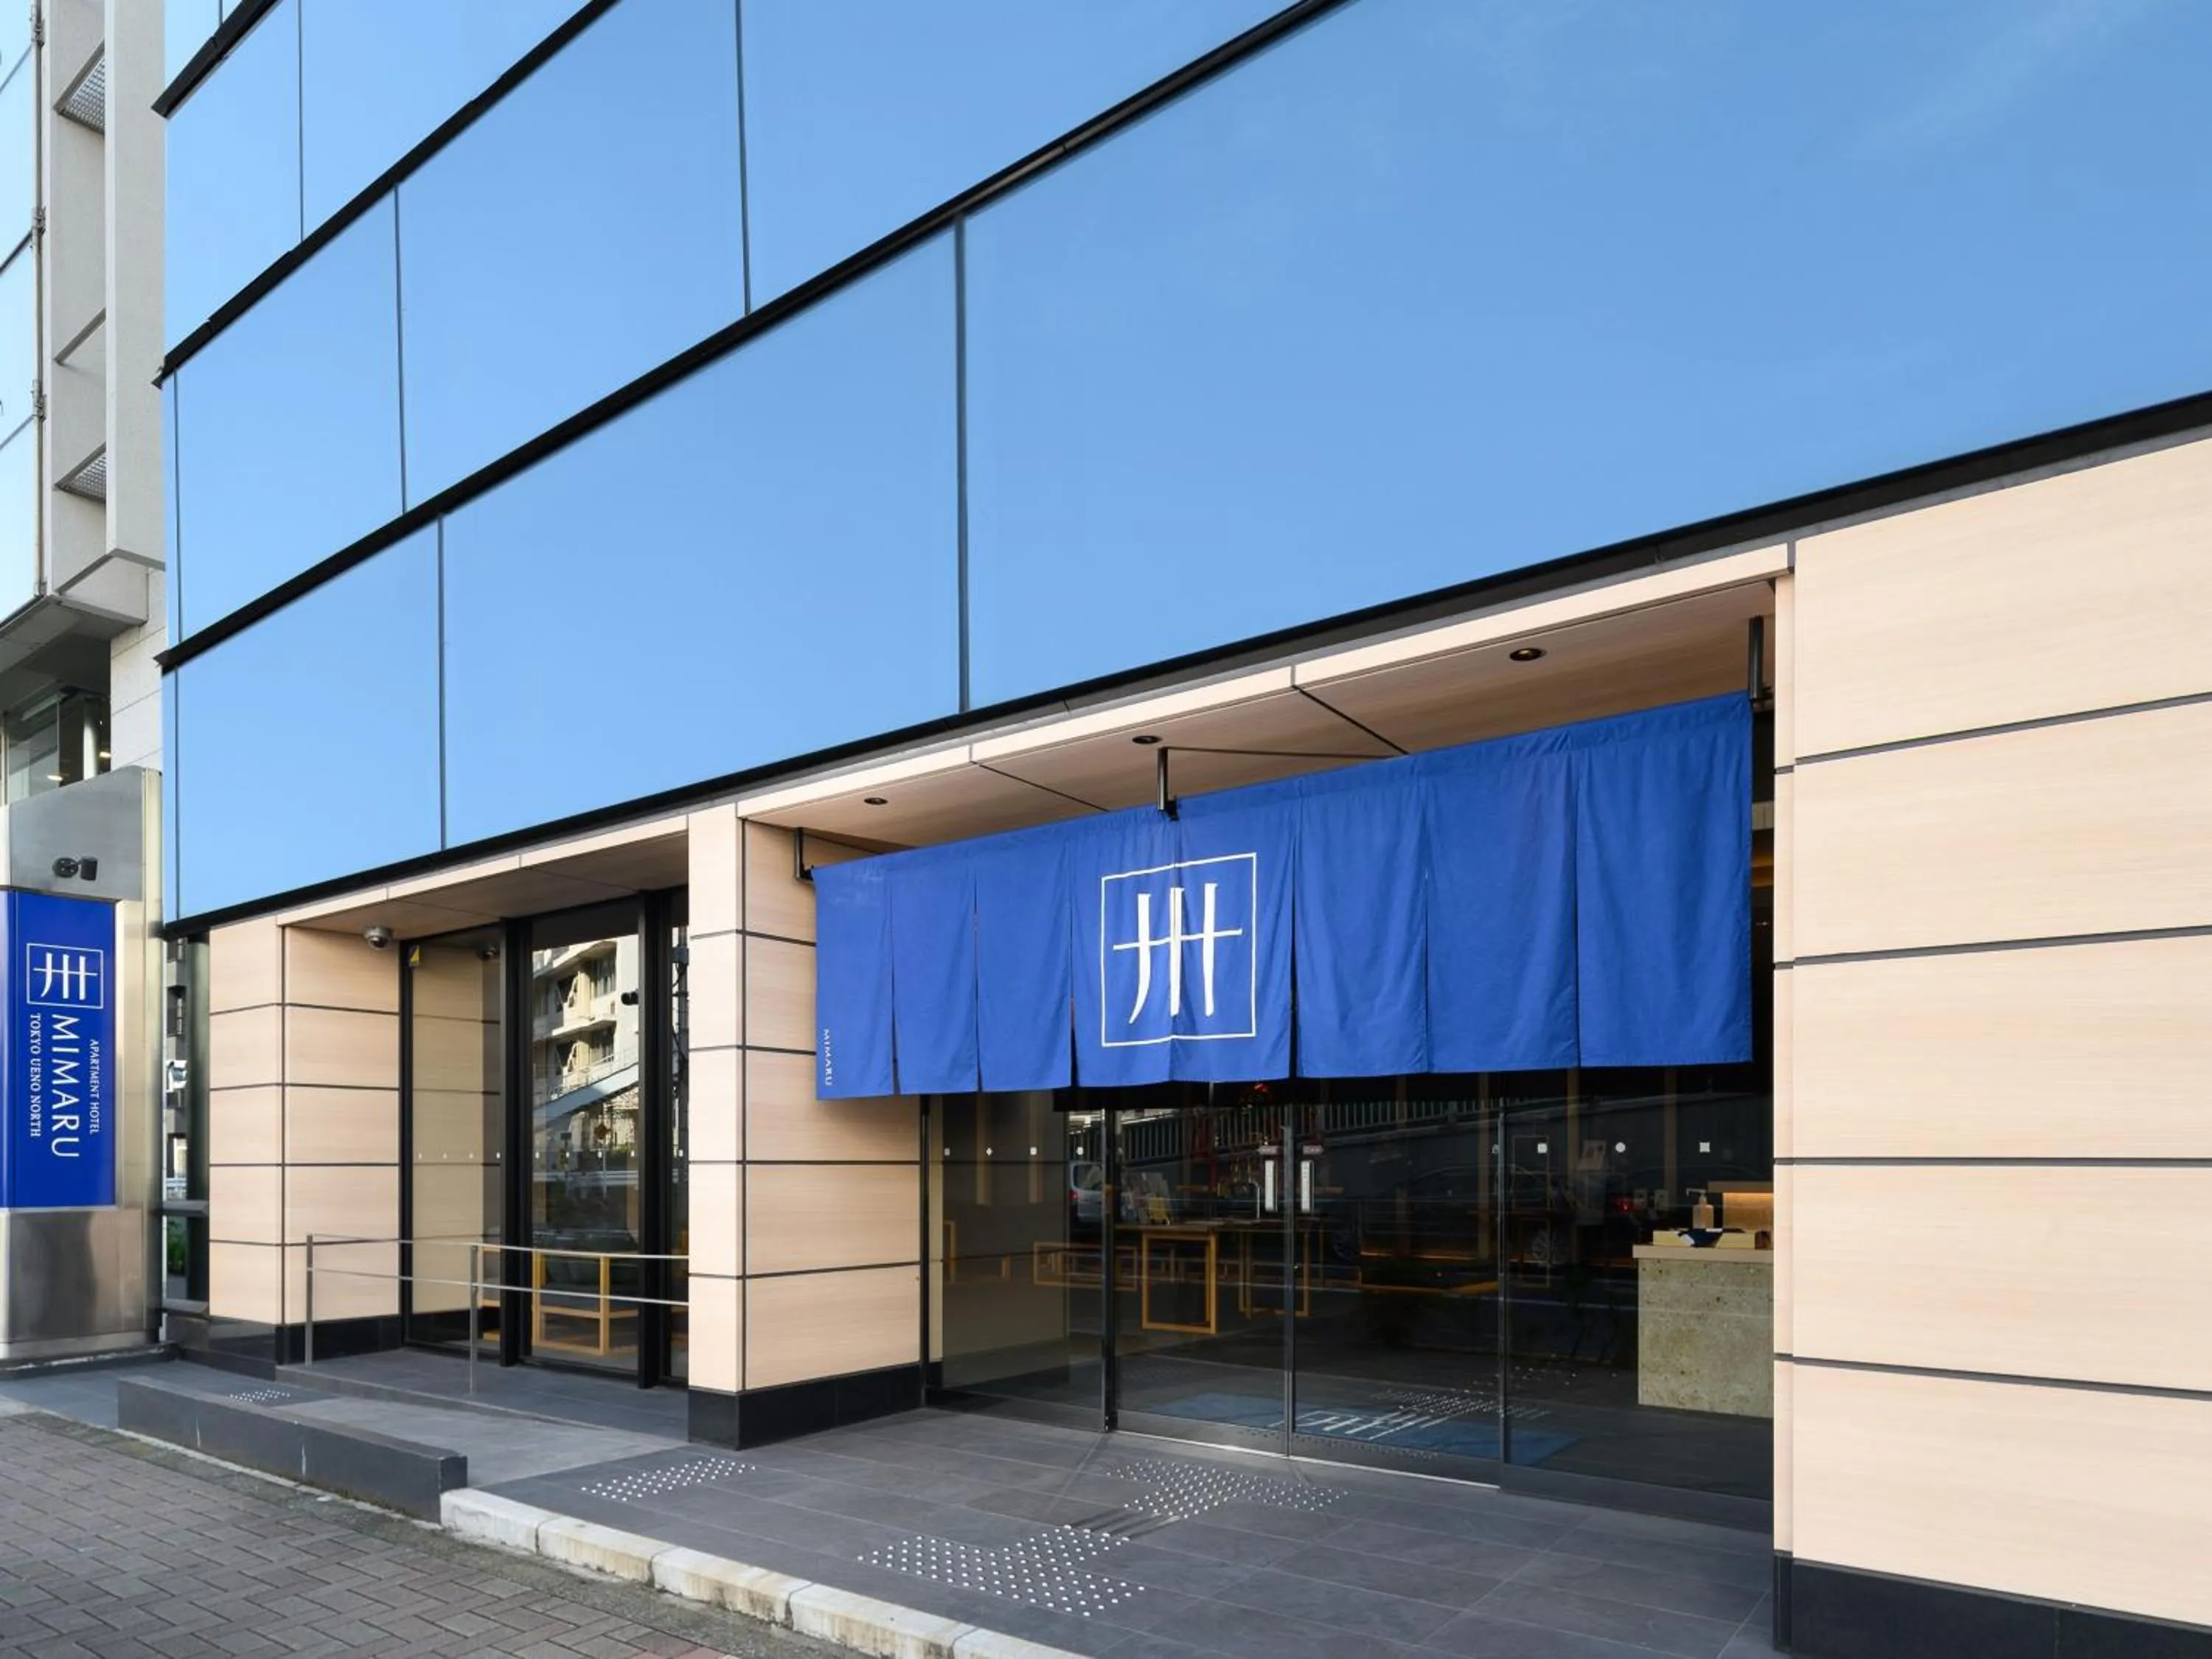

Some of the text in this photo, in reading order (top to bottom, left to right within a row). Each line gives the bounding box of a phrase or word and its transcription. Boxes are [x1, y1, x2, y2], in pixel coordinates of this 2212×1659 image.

[29, 1013, 41, 1137] TOKYO UENO NORTH
[51, 1014, 80, 1158] MIMARU
[89, 1039, 100, 1134] APARTMENT HOTEL
[822, 1028, 832, 1086] MIMARU
